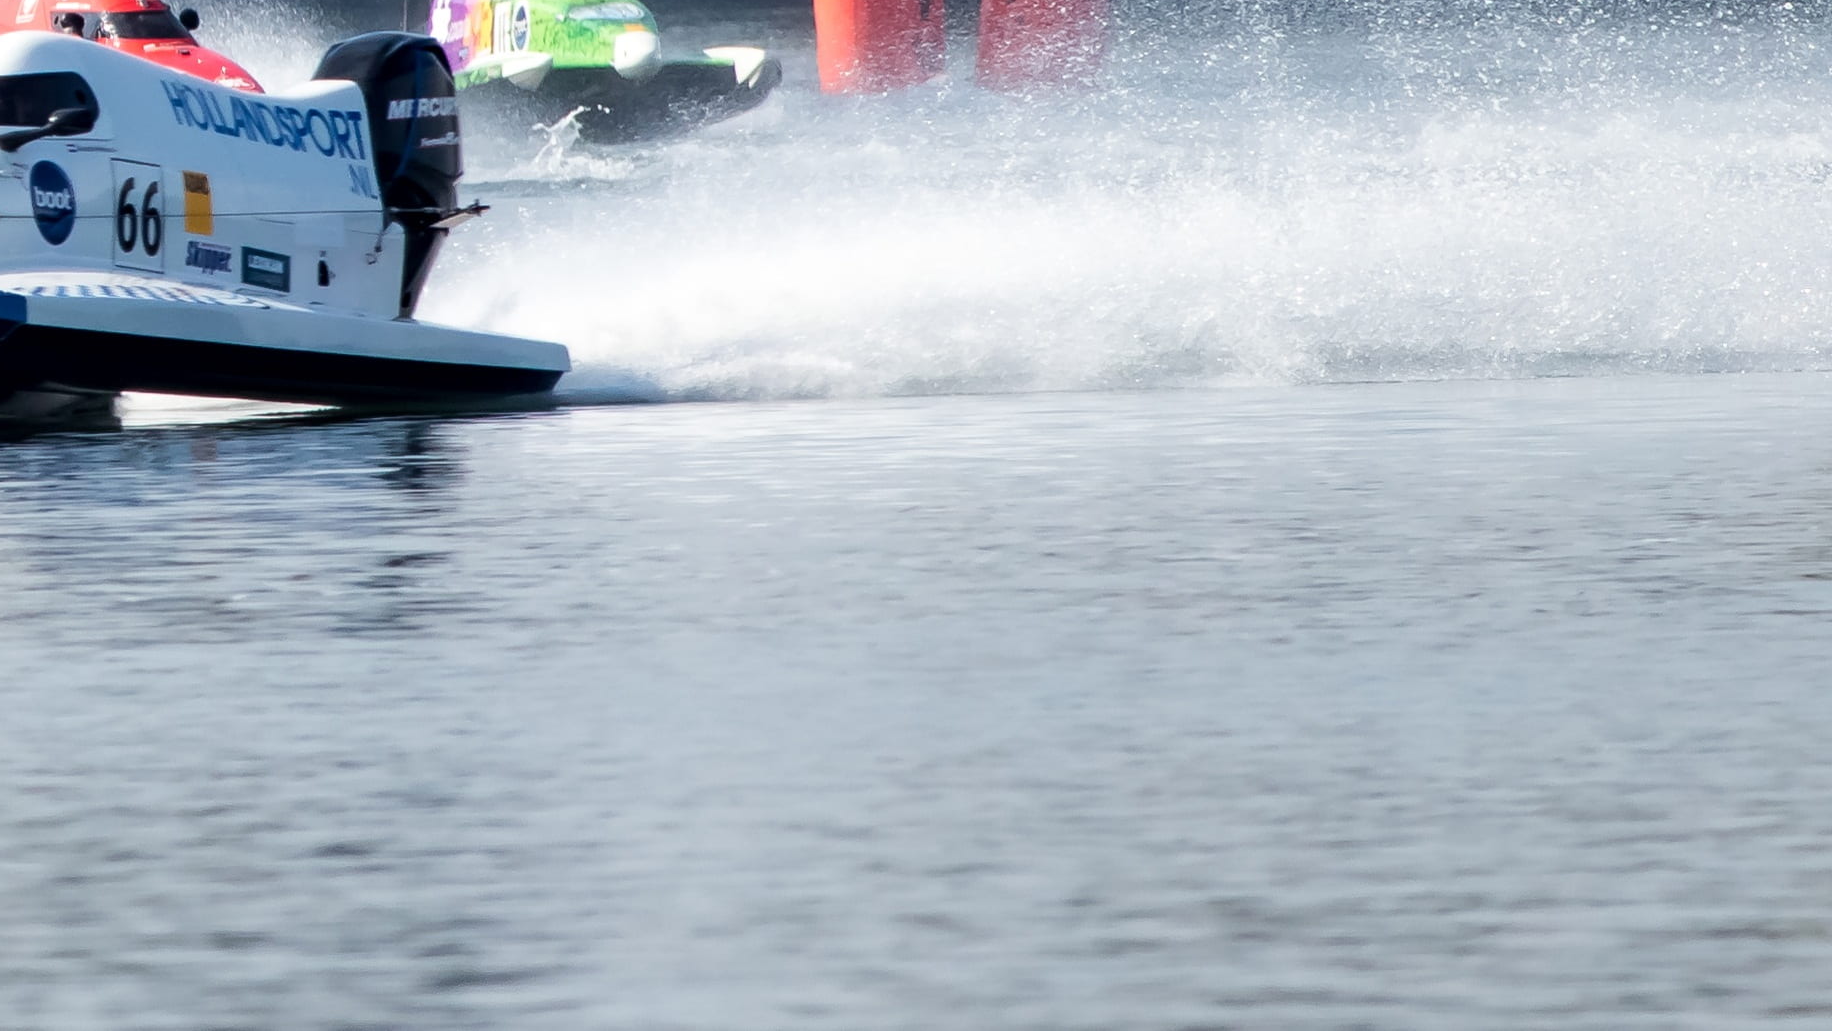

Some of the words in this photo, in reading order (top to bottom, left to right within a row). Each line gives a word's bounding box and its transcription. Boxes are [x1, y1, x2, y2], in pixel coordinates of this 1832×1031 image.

[160, 79, 367, 160] HOLLANDSPORT
[32, 185, 73, 211] boot
[118, 176, 162, 257] 66
